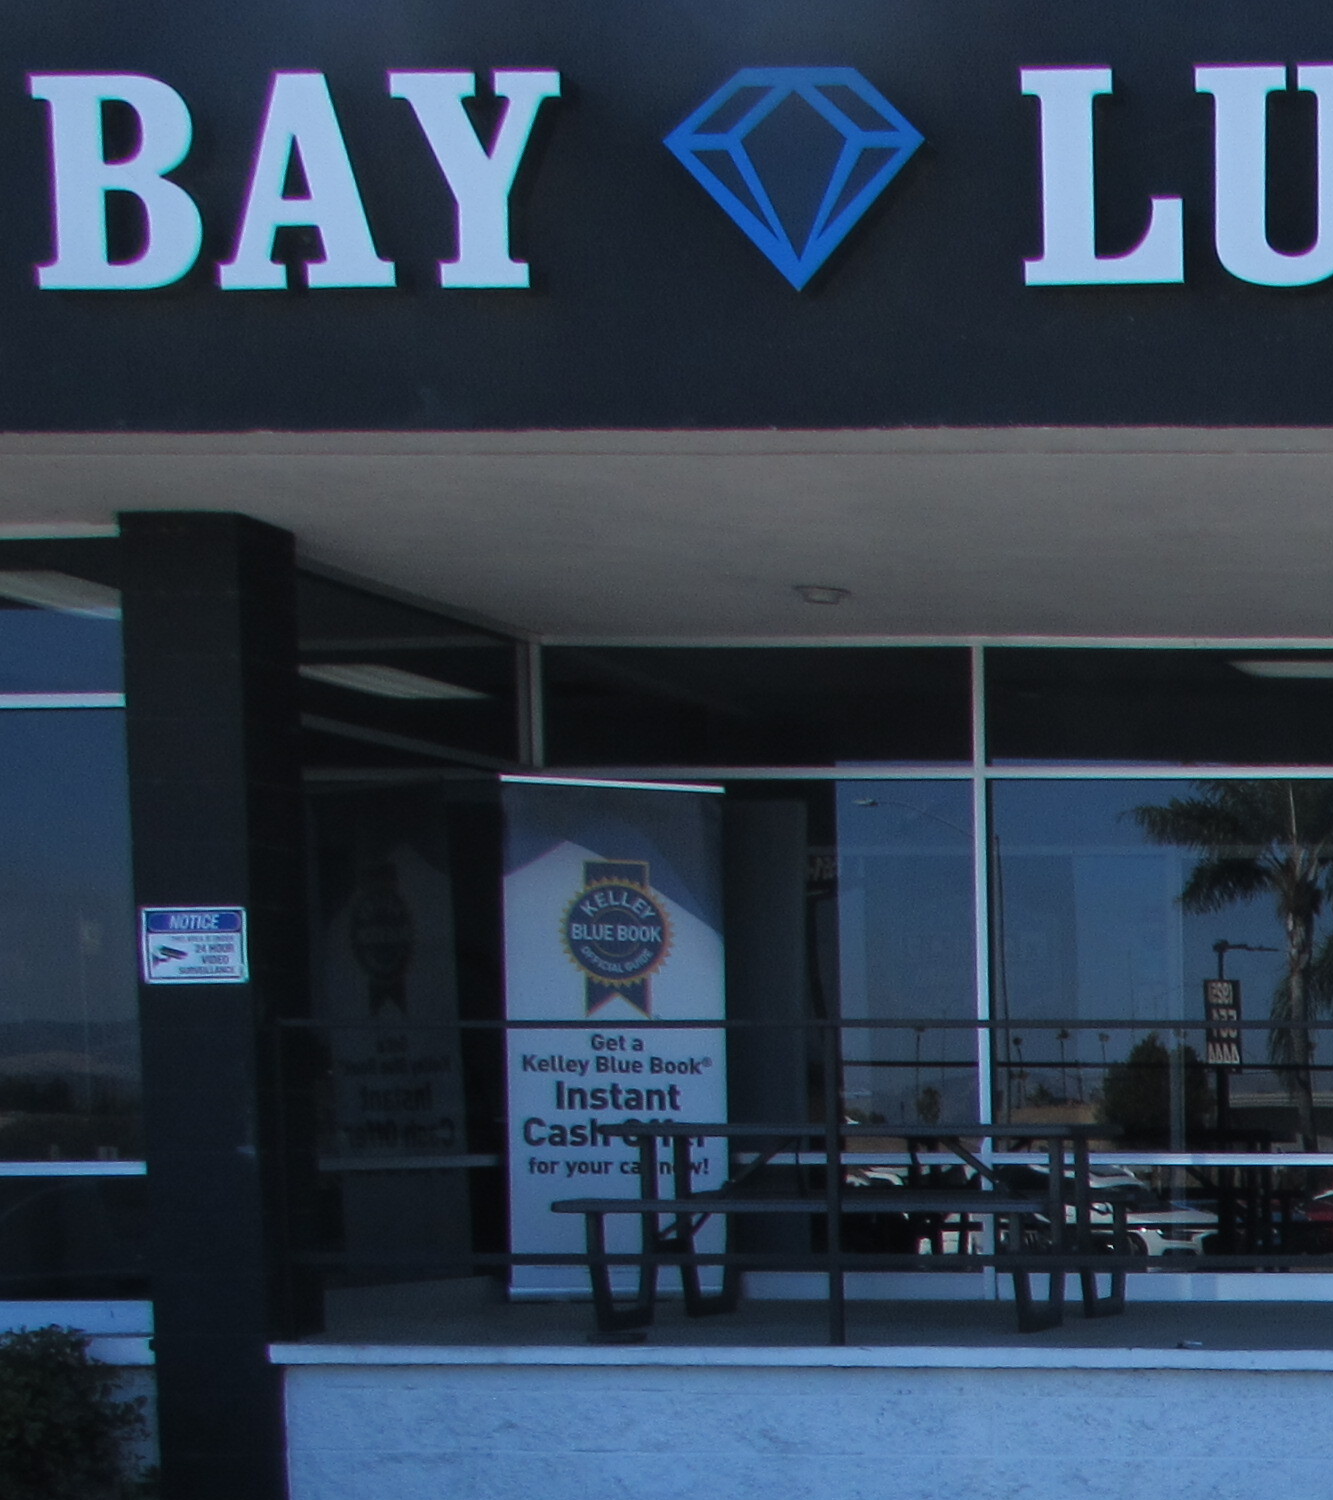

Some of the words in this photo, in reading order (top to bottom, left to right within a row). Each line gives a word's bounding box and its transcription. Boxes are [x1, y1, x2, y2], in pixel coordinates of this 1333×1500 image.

[29, 71, 561, 288] BAY
[580, 890, 656, 919] KELLEY
[169, 914, 220, 930] NOTICE
[572, 923, 614, 941] BLUE
[617, 925, 662, 943] BOOK
[581, 946, 624, 973] OFFICIAL
[626, 948, 654, 972] GUIDE
[591, 1034, 626, 1051] Get
[632, 1037, 644, 1051] a
[522, 1054, 590, 1076] Kelley
[596, 1055, 643, 1073] Blue
[555, 1080, 682, 1111] Instant
[523, 1117, 611, 1147] Cash
[529, 1157, 557, 1175] for
[566, 1160, 614, 1178] your
[659, 1158, 710, 1175] nw!
